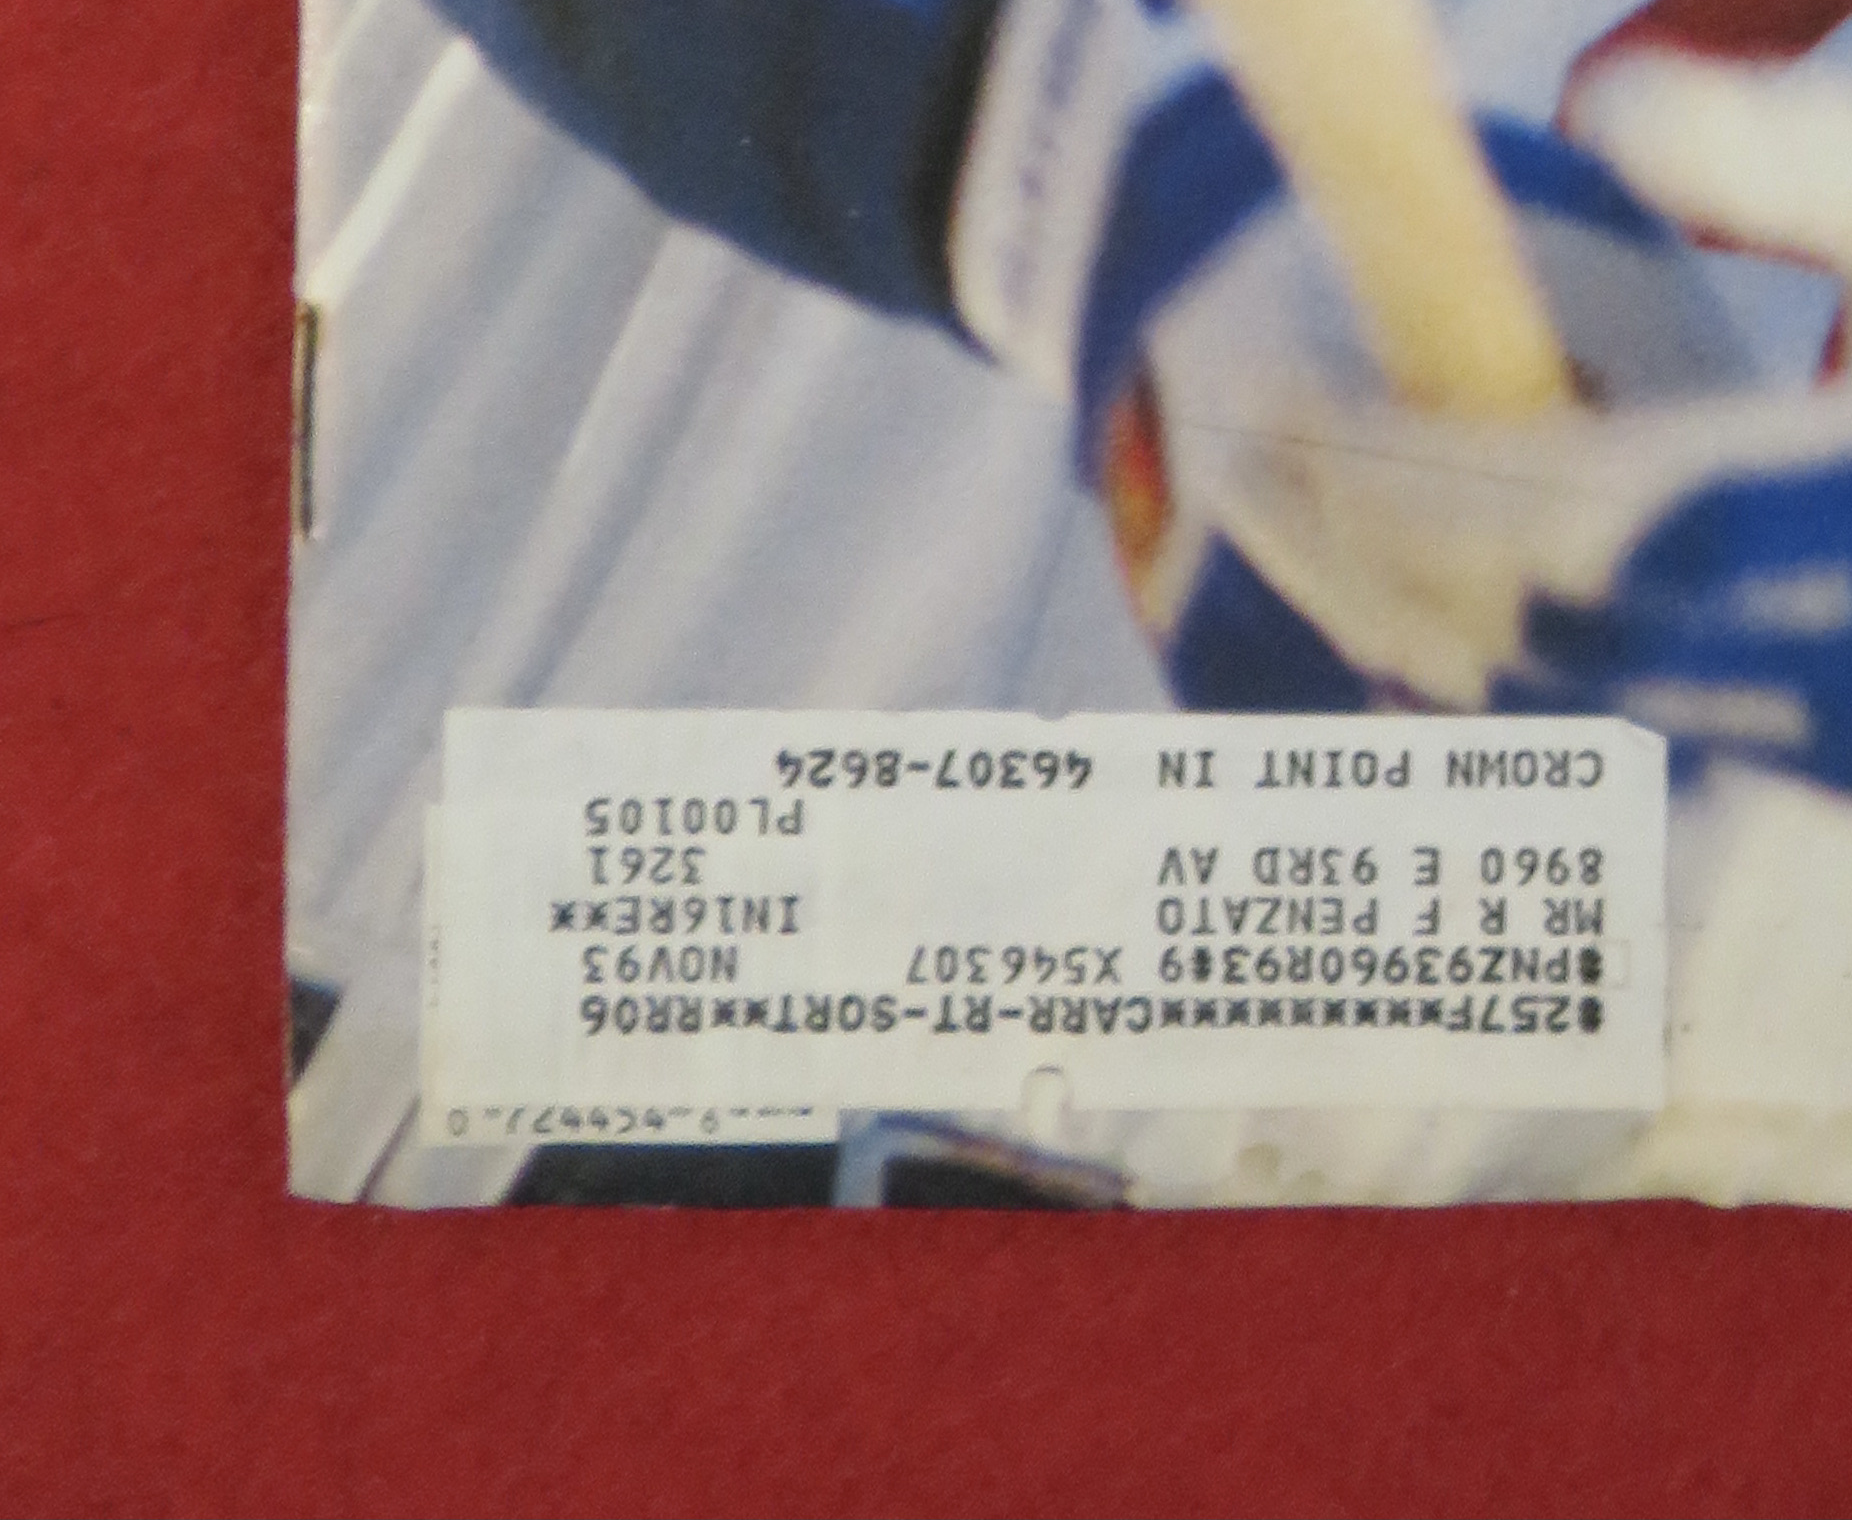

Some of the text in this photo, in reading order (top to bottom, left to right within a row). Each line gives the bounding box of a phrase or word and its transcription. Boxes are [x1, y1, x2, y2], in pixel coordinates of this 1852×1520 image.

[773, 747, 1605, 789] CROWN POINT IN 46307-8624
[586, 845, 1605, 886] 8960 E 93RD AV 3261
[1156, 896, 1380, 936] PENZATO
[1413, 896, 1442, 936] F
[1479, 896, 1508, 935] R
[1543, 896, 1605, 936] MR
[580, 944, 739, 984] NOV93
[904, 944, 1122, 985] X546307
